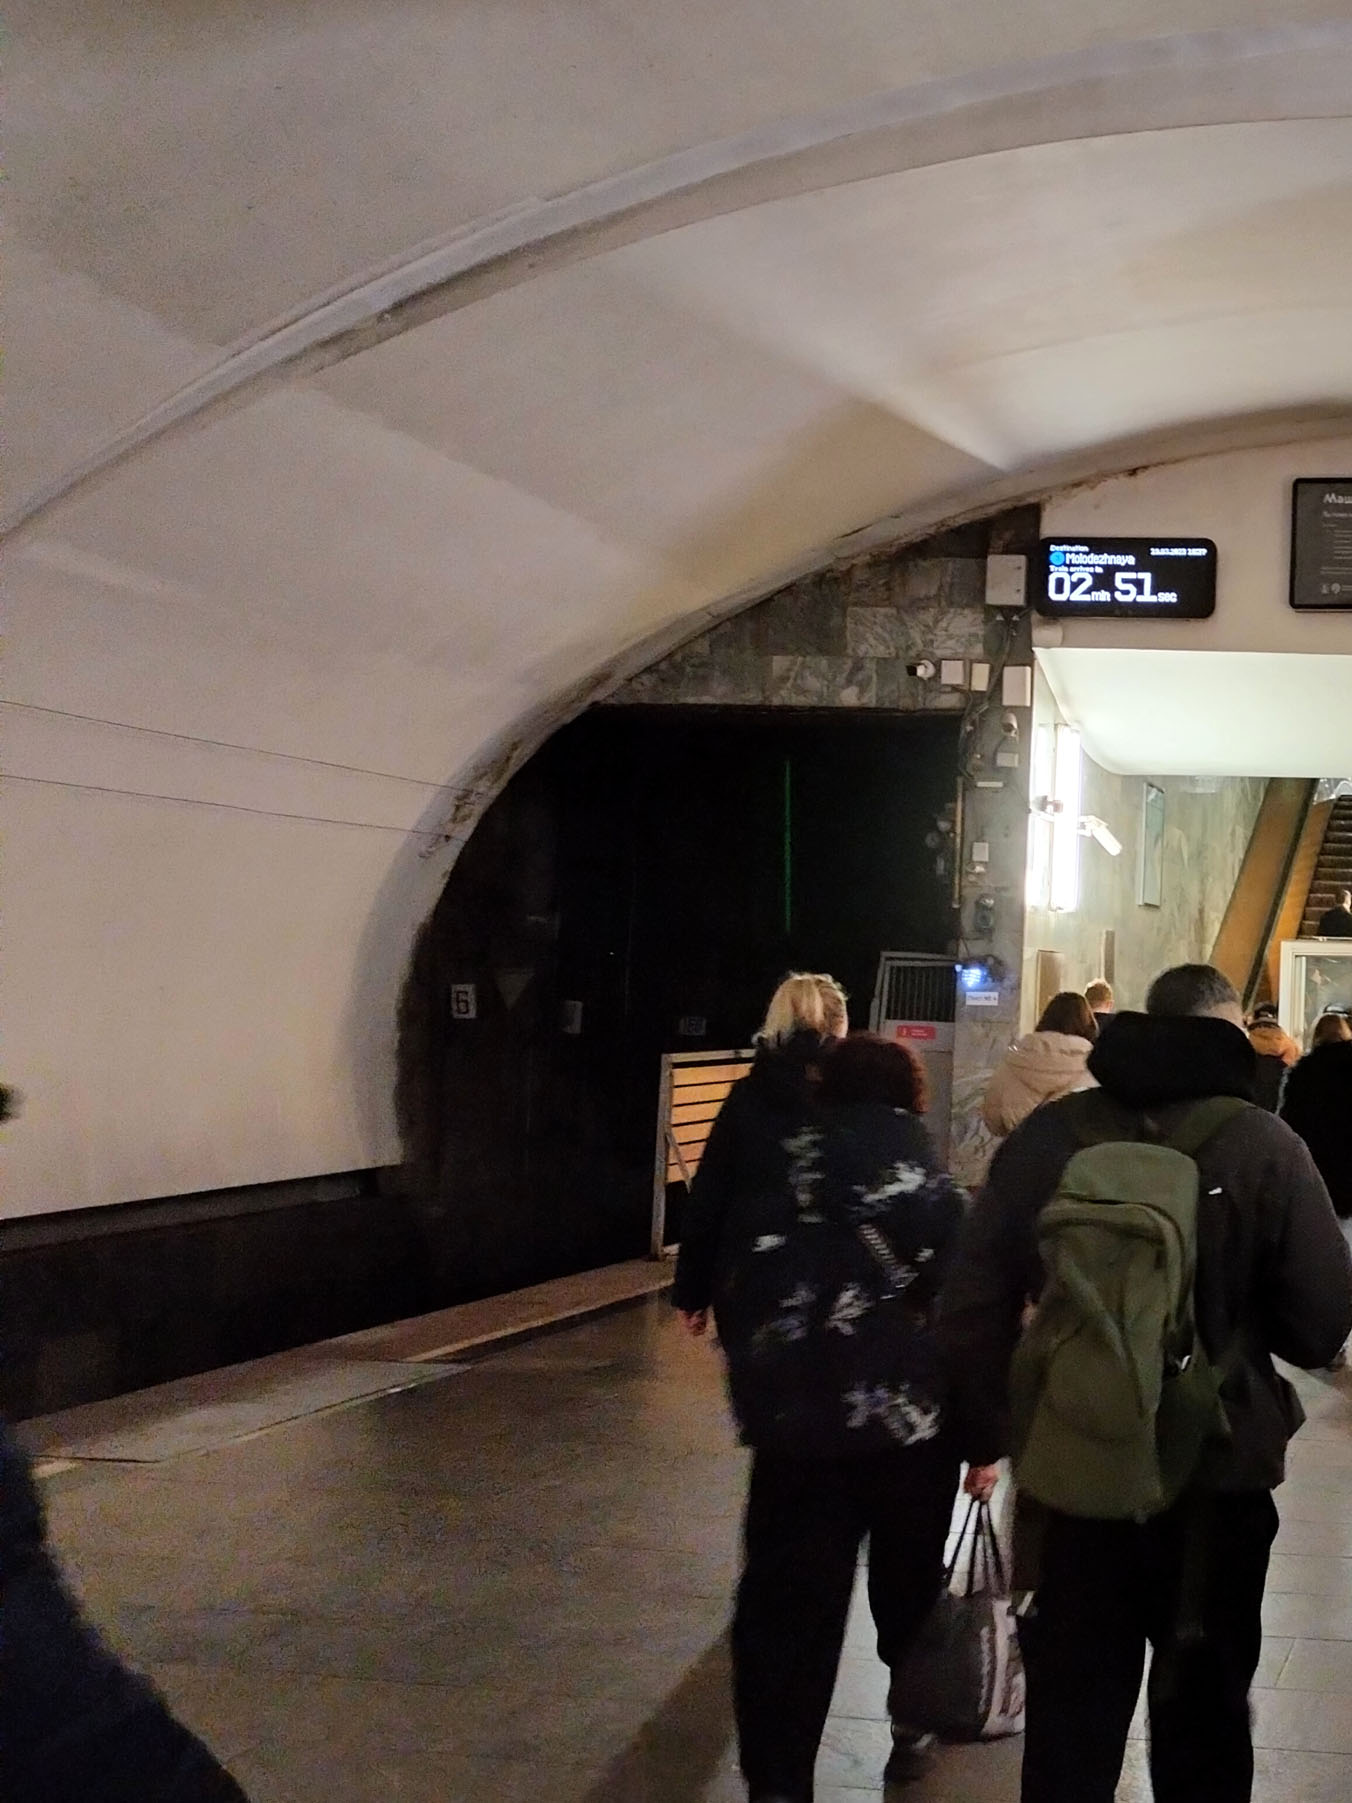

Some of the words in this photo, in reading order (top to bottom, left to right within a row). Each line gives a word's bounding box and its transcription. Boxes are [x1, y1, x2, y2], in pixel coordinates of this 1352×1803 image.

[1065, 552, 1135, 566] Molodezhnaya
[1048, 571, 1093, 602] 02
[1092, 590, 1111, 602] min
[1114, 571, 1158, 602] 51
[1157, 591, 1178, 603] sec
